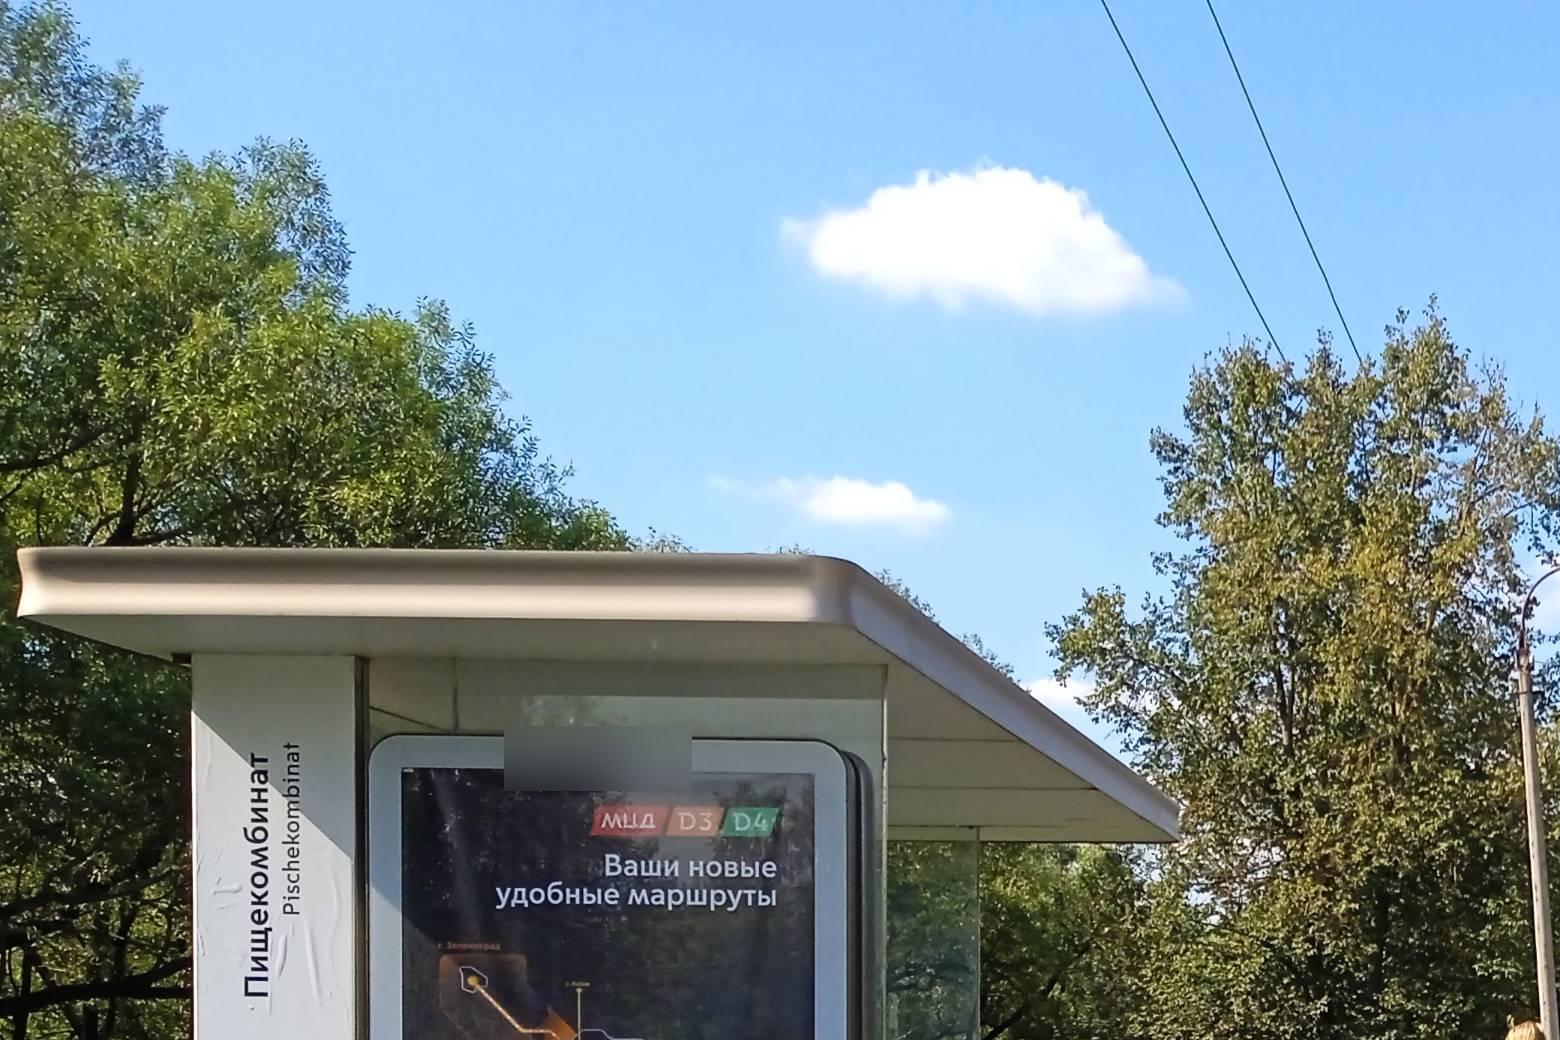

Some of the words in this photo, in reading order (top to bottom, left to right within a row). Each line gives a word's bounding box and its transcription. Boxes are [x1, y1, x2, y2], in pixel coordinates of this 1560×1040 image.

[282, 742, 301, 915] Pischekombinat
[600, 812, 657, 830] МЦД
[677, 811, 714, 831] D3
[732, 811, 772, 833] D4
[243, 752, 273, 998] Пищекомбинат
[603, 853, 680, 878] Ваши
[688, 860, 778, 879] новые
[495, 881, 620, 910] удобные
[627, 887, 777, 912] маршруты
